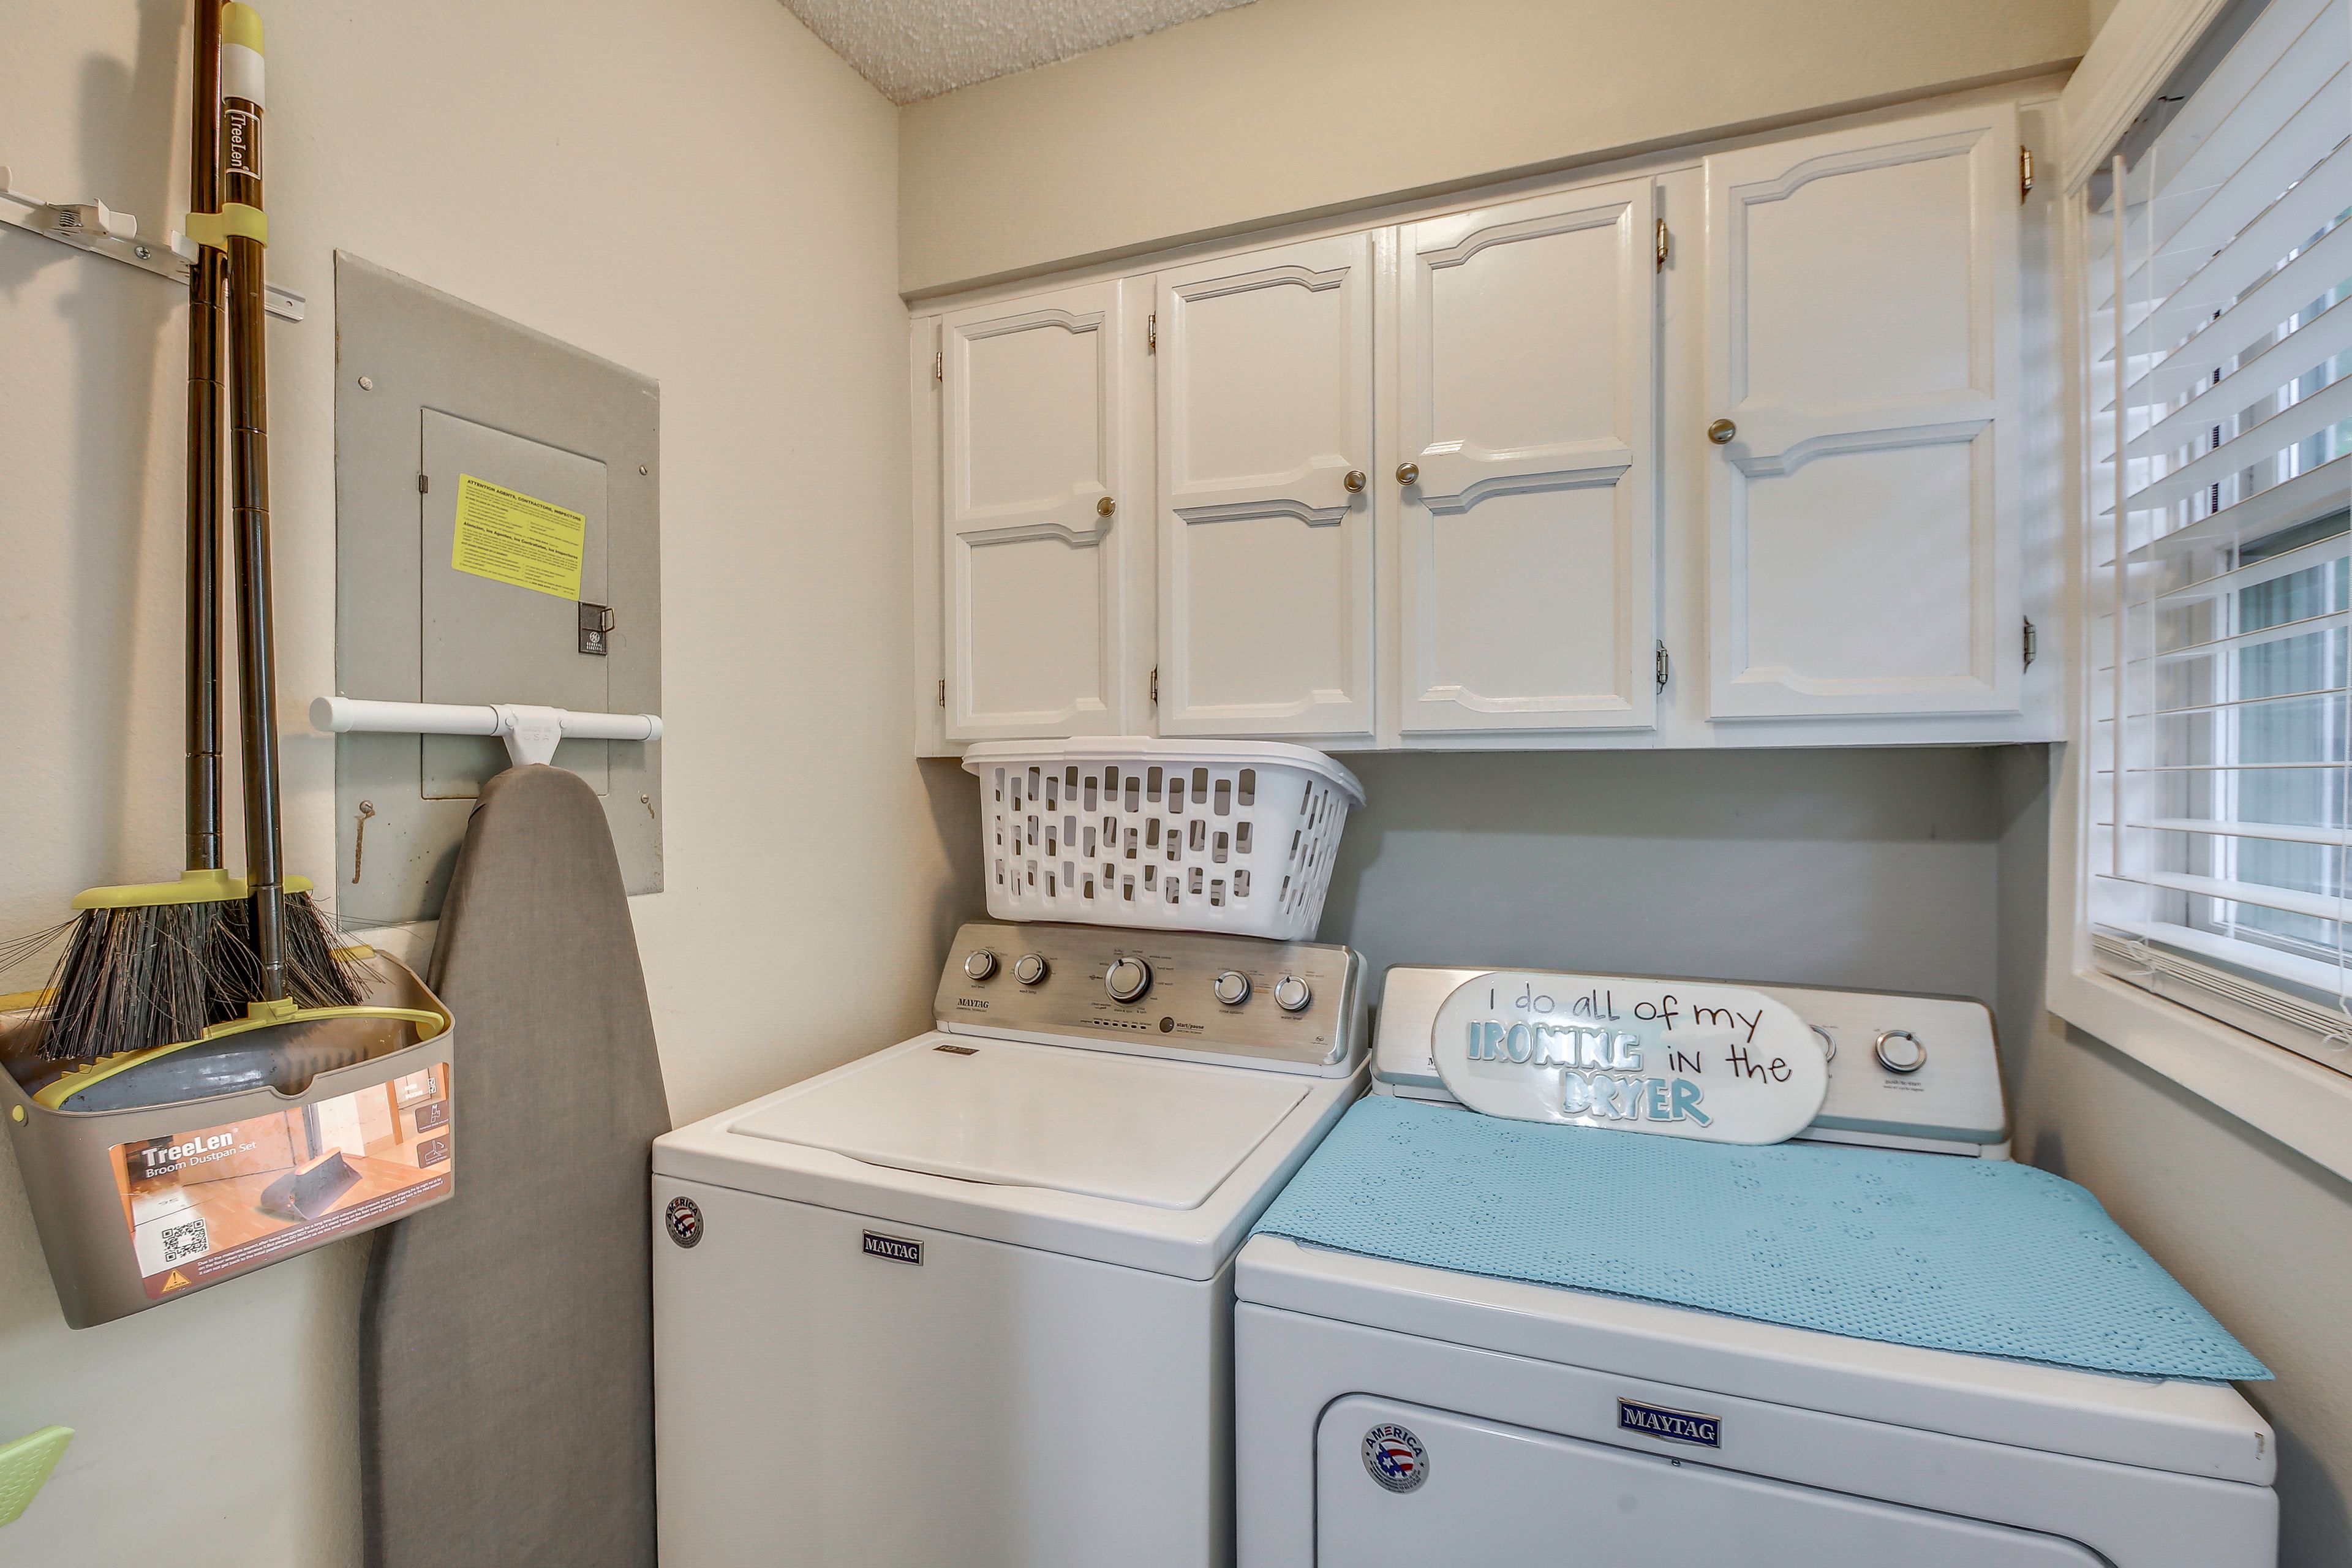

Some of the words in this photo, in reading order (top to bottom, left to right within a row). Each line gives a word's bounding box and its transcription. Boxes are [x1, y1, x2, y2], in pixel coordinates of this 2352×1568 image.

[231, 115, 246, 168] TreeLen
[467, 479, 495, 492] ATTENTION
[554, 508, 581, 521] INSPECTORS
[957, 998, 989, 1009] MAYTAG
[1515, 982, 1556, 1014] do
[1634, 995, 1679, 1031] of
[1693, 1004, 1763, 1044] my
[1468, 1021, 1643, 1072] IRONING
[1725, 1043, 1792, 1084] the
[1564, 1071, 1713, 1128] DRYER
[141, 1132, 233, 1167] TreeLen
[145, 1161, 187, 1178] Broom
[190, 1147, 236, 1167] Dustpan
[239, 1141, 257, 1153] Set
[666, 1198, 698, 1221] AMERICA
[864, 1237, 918, 1261] MAYTAG
[1365, 1425, 1423, 1458] AMERICA
[1623, 1406, 1716, 1441] MAYTAG
